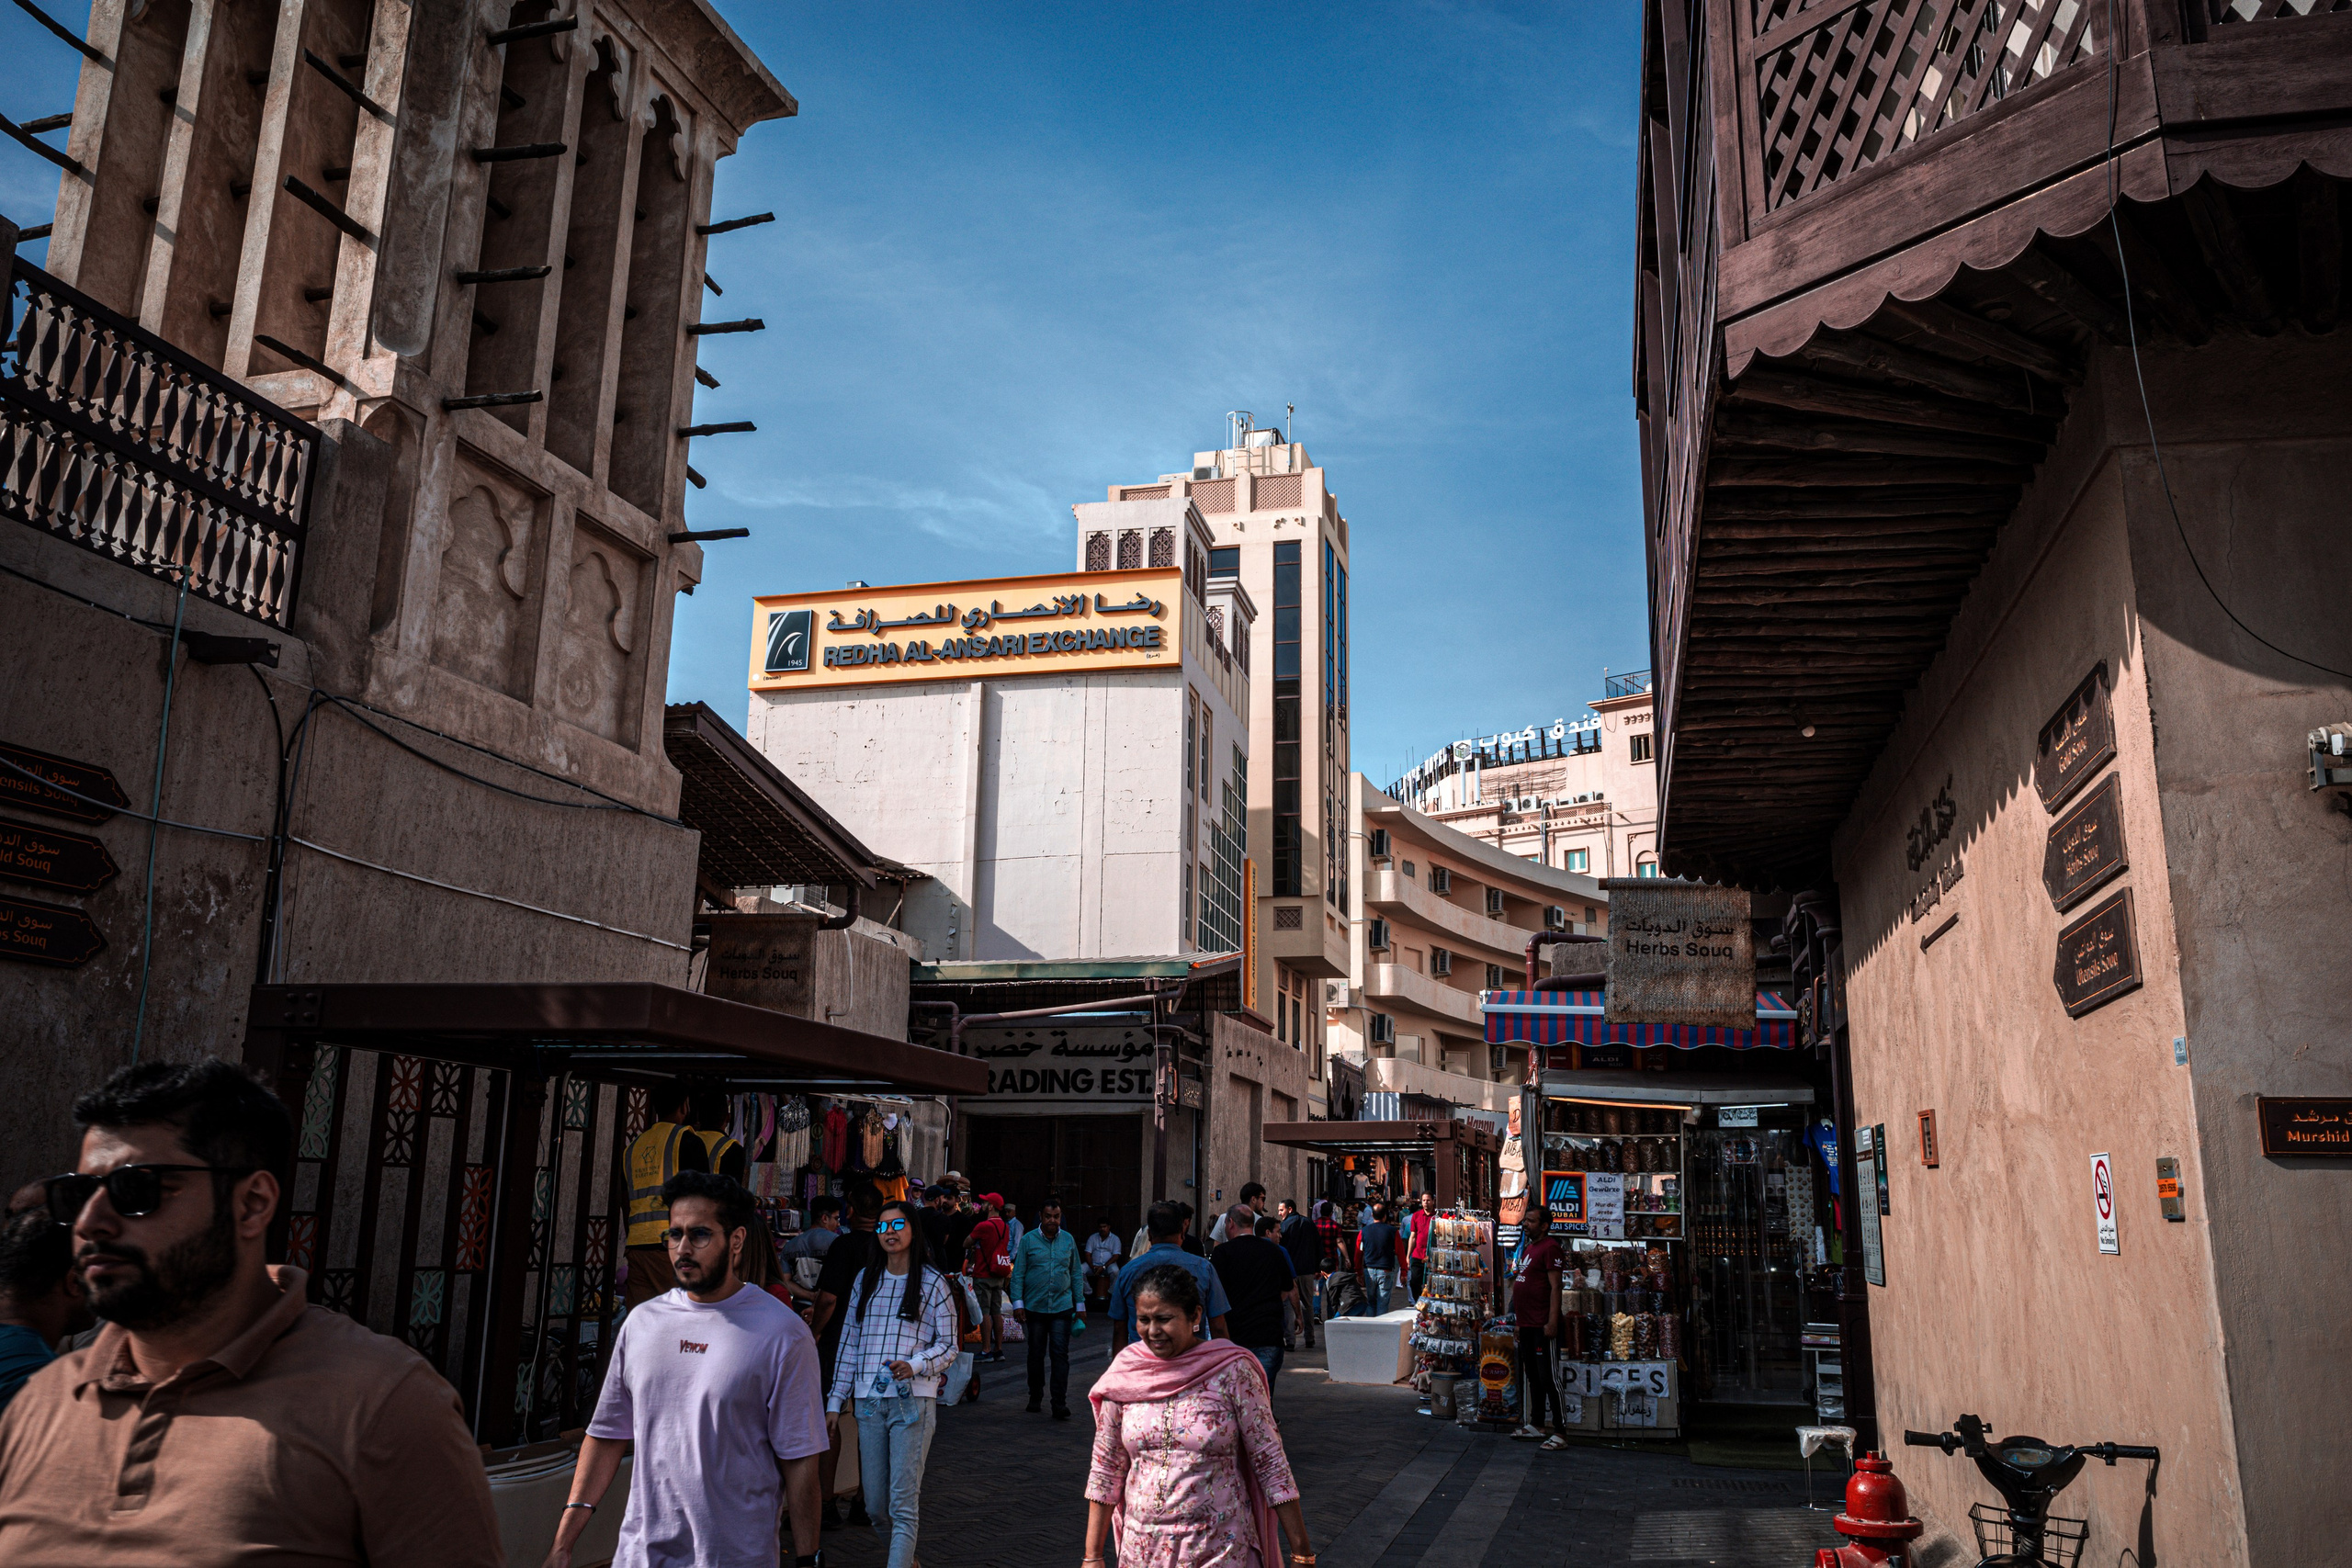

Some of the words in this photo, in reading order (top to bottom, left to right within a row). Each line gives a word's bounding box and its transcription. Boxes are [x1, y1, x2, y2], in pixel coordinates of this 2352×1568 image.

[1094, 592, 1160, 616] رضا
[827, 603, 955, 635] للصرافة
[823, 642, 900, 667] REDHA
[903, 634, 1024, 661] AL-ANSARI
[1028, 626, 1160, 653] EXCHANGE
[787, 659, 803, 667] 1945
[1549, 713, 1601, 740] فندق
[1478, 724, 1537, 753] كيوب
[2059, 747, 2073, 773] Gold
[2072, 736, 2087, 761] Souq
[0, 774, 40, 795] ensils
[17, 853, 51, 874] Souq
[2066, 855, 2083, 878] Herbs
[2083, 844, 2098, 866] Souq
[1625, 919, 1687, 938] الدويات
[1691, 920, 1735, 939] سوق
[13, 930, 47, 950] Souq
[1626, 939, 1679, 956] Herbs
[1685, 942, 1734, 960] Souq
[768, 949, 800, 964] سوق
[719, 966, 758, 979] Herbs
[762, 967, 797, 982] Souq
[2076, 959, 2101, 987] Utensils
[2102, 953, 2119, 973] Souq
[1051, 1031, 1155, 1063] مؤسسة
[988, 1068, 1094, 1094] RADING
[1102, 1069, 1153, 1094] EST.
[2292, 1110, 2339, 1125] مرشد
[2288, 1130, 2350, 1143] Murshid
[1549, 1201, 1579, 1213] ALDI
[1564, 1223, 1589, 1231] SPICES
